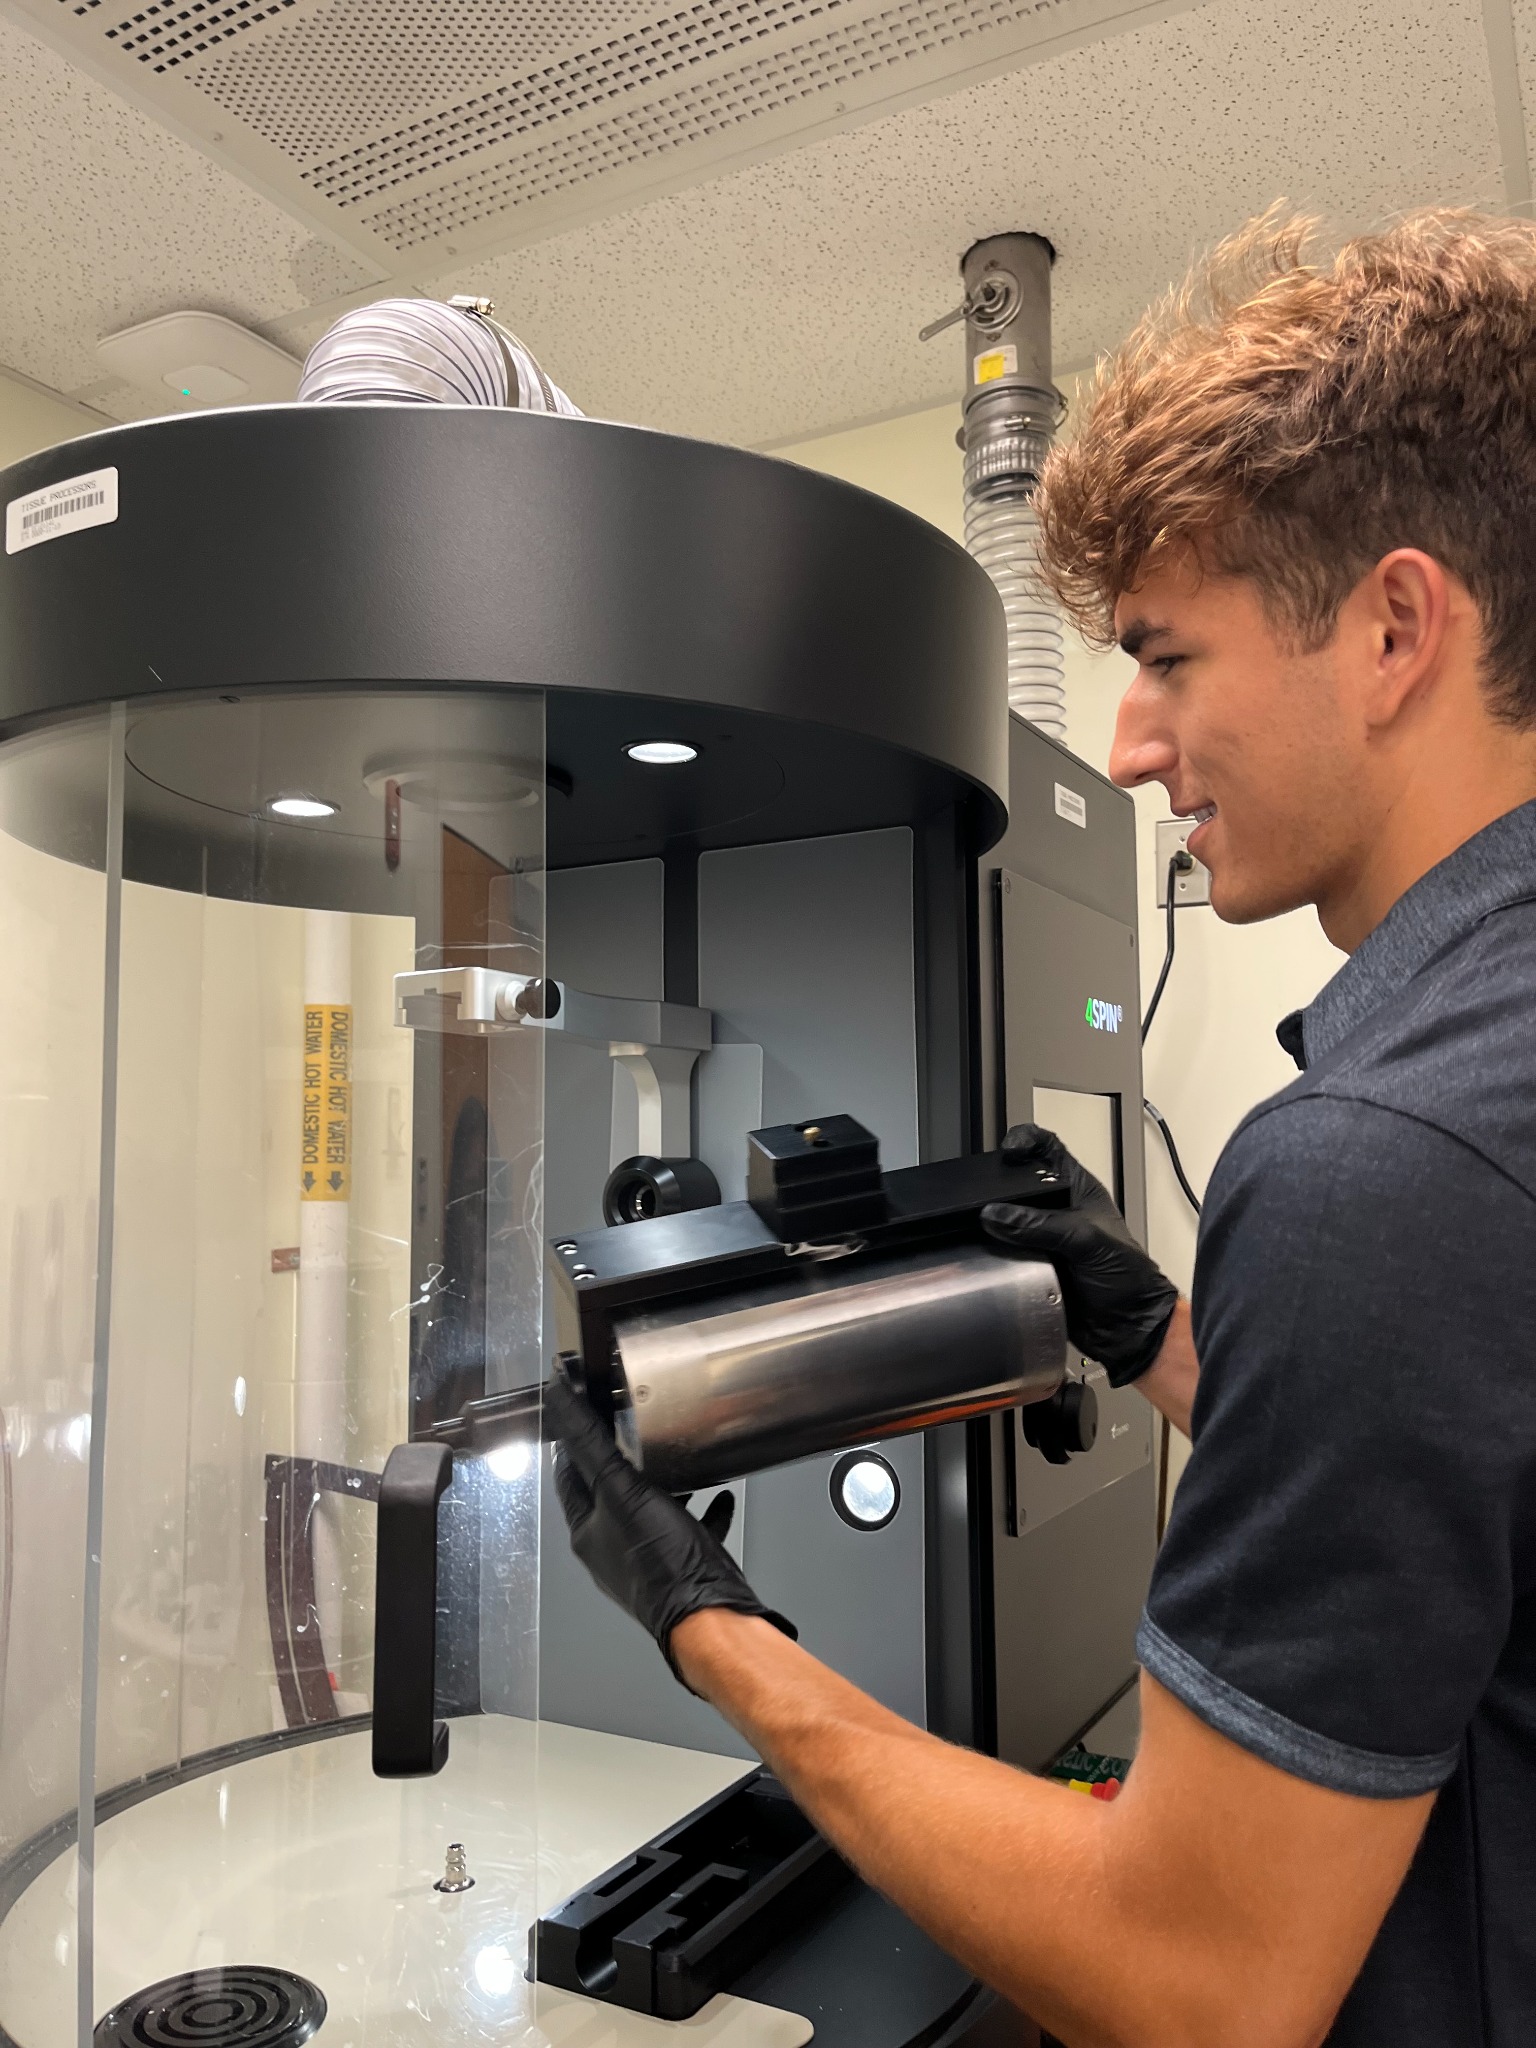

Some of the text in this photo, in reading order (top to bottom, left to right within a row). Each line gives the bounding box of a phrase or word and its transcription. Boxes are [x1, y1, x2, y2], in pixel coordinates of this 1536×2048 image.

[22, 480, 97, 513] TISSUE PROCESSORS
[302, 1011, 323, 1164] DOMESTIC HOT WATER
[327, 1011, 349, 1164] DOMESTIC HOT WATER
